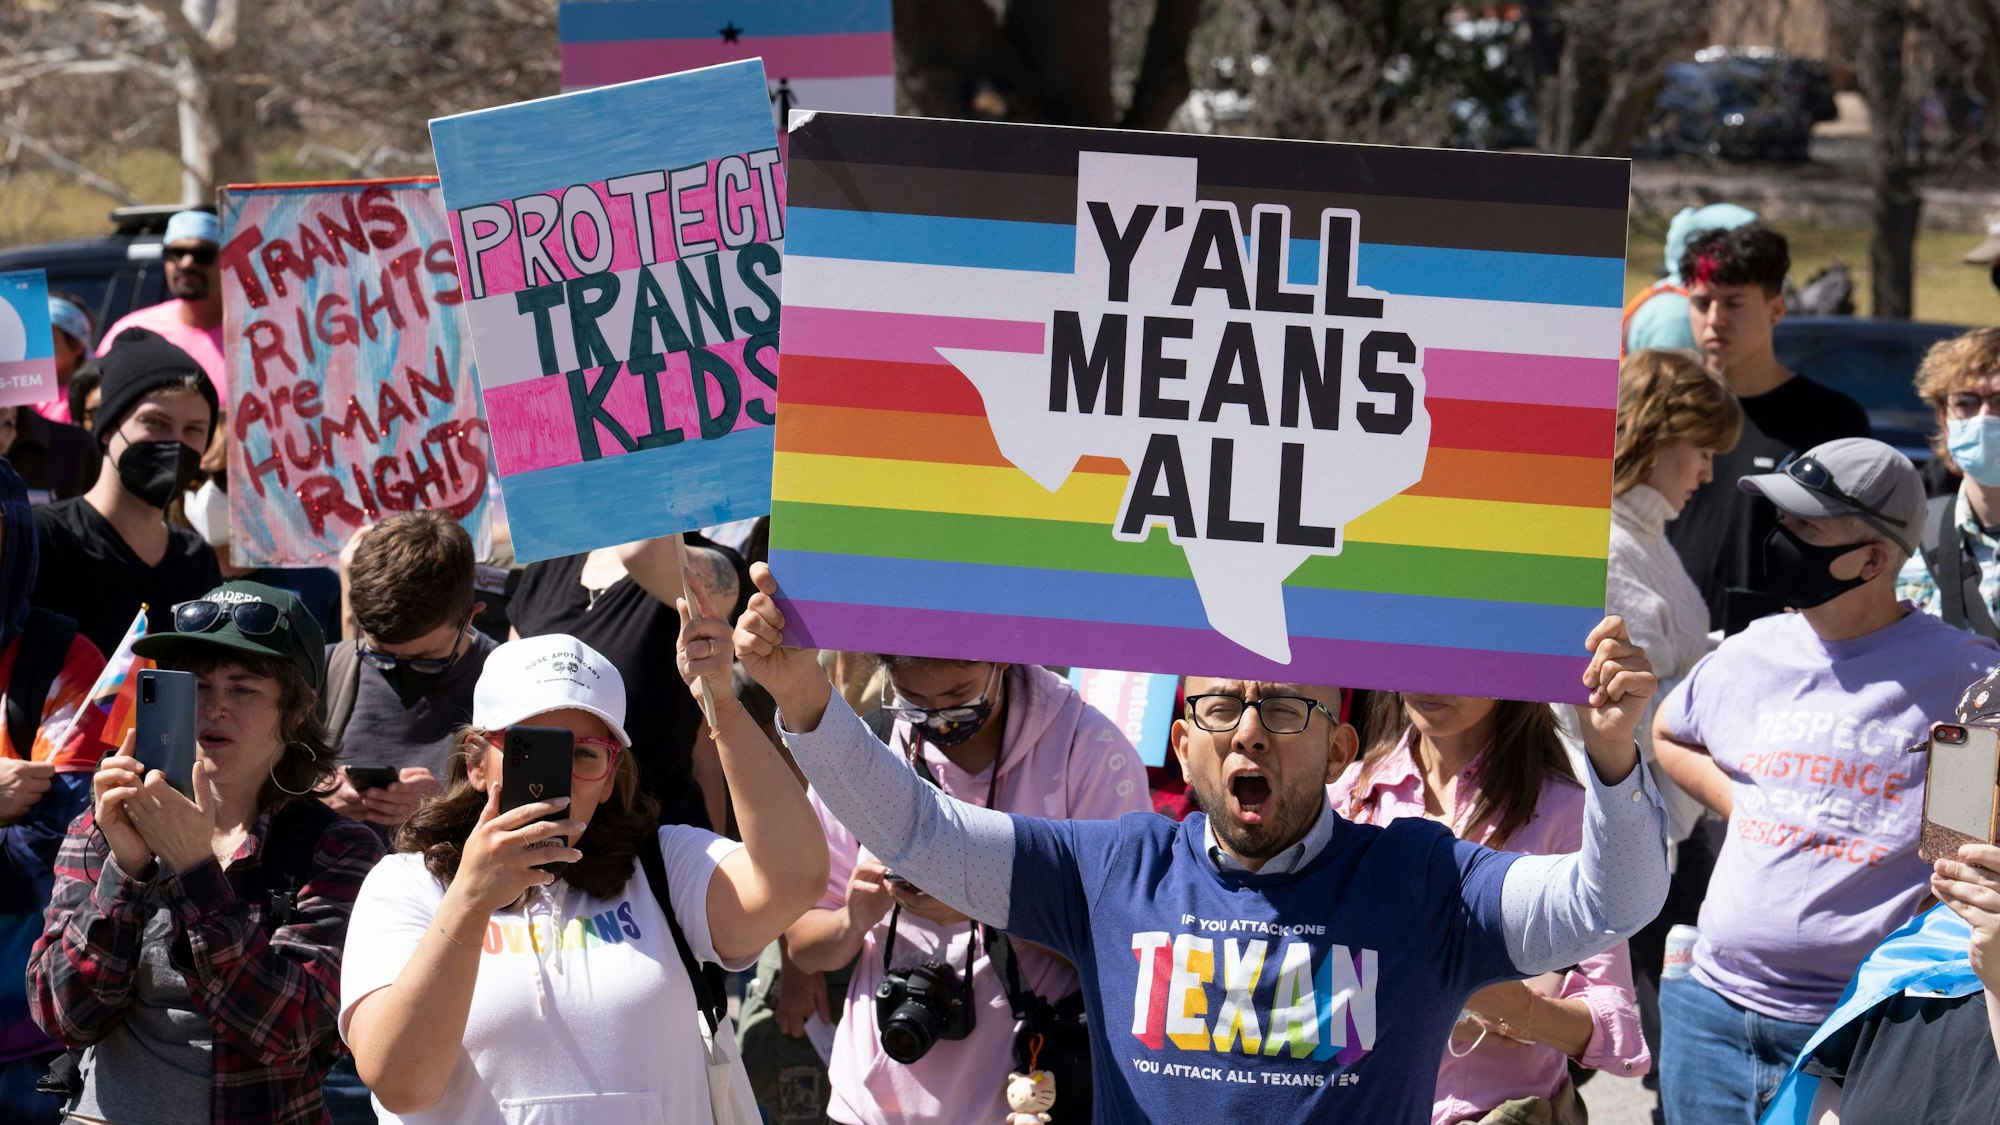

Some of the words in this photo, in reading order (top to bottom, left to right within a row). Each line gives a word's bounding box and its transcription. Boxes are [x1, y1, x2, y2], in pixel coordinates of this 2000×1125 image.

[220, 187, 408, 308] TRANS
[458, 147, 784, 299] PROTECT
[1087, 201, 1384, 318] Y'ALL
[243, 240, 465, 388] RIGHTS
[515, 242, 782, 377] TRANS
[244, 345, 454, 498] HUMAN
[566, 332, 780, 462] KIDS
[1049, 310, 1416, 435] MEANS
[295, 417, 488, 537] RIGHTS
[1120, 433, 1336, 548] ALL
[1124, 672, 1151, 743] rotect
[1754, 711, 1913, 757] RESPECT
[1739, 751, 1908, 804] EXISTENCE
[1770, 788, 1898, 835] EXPECT
[1737, 818, 1890, 868] RESISTANCE
[483, 920, 545, 954] OVE
[1181, 914, 1195, 925] IF
[1199, 919, 1226, 931] YOU
[1230, 919, 1289, 936] ATTACK
[1292, 924, 1326, 935] ONE
[1131, 931, 1379, 1065] TEXAN
[1133, 1059, 1159, 1074] YOU
[1163, 1063, 1222, 1081] ATTACK
[1226, 1070, 1256, 1084] ALL
[1261, 1073, 1324, 1087] TEXANS
